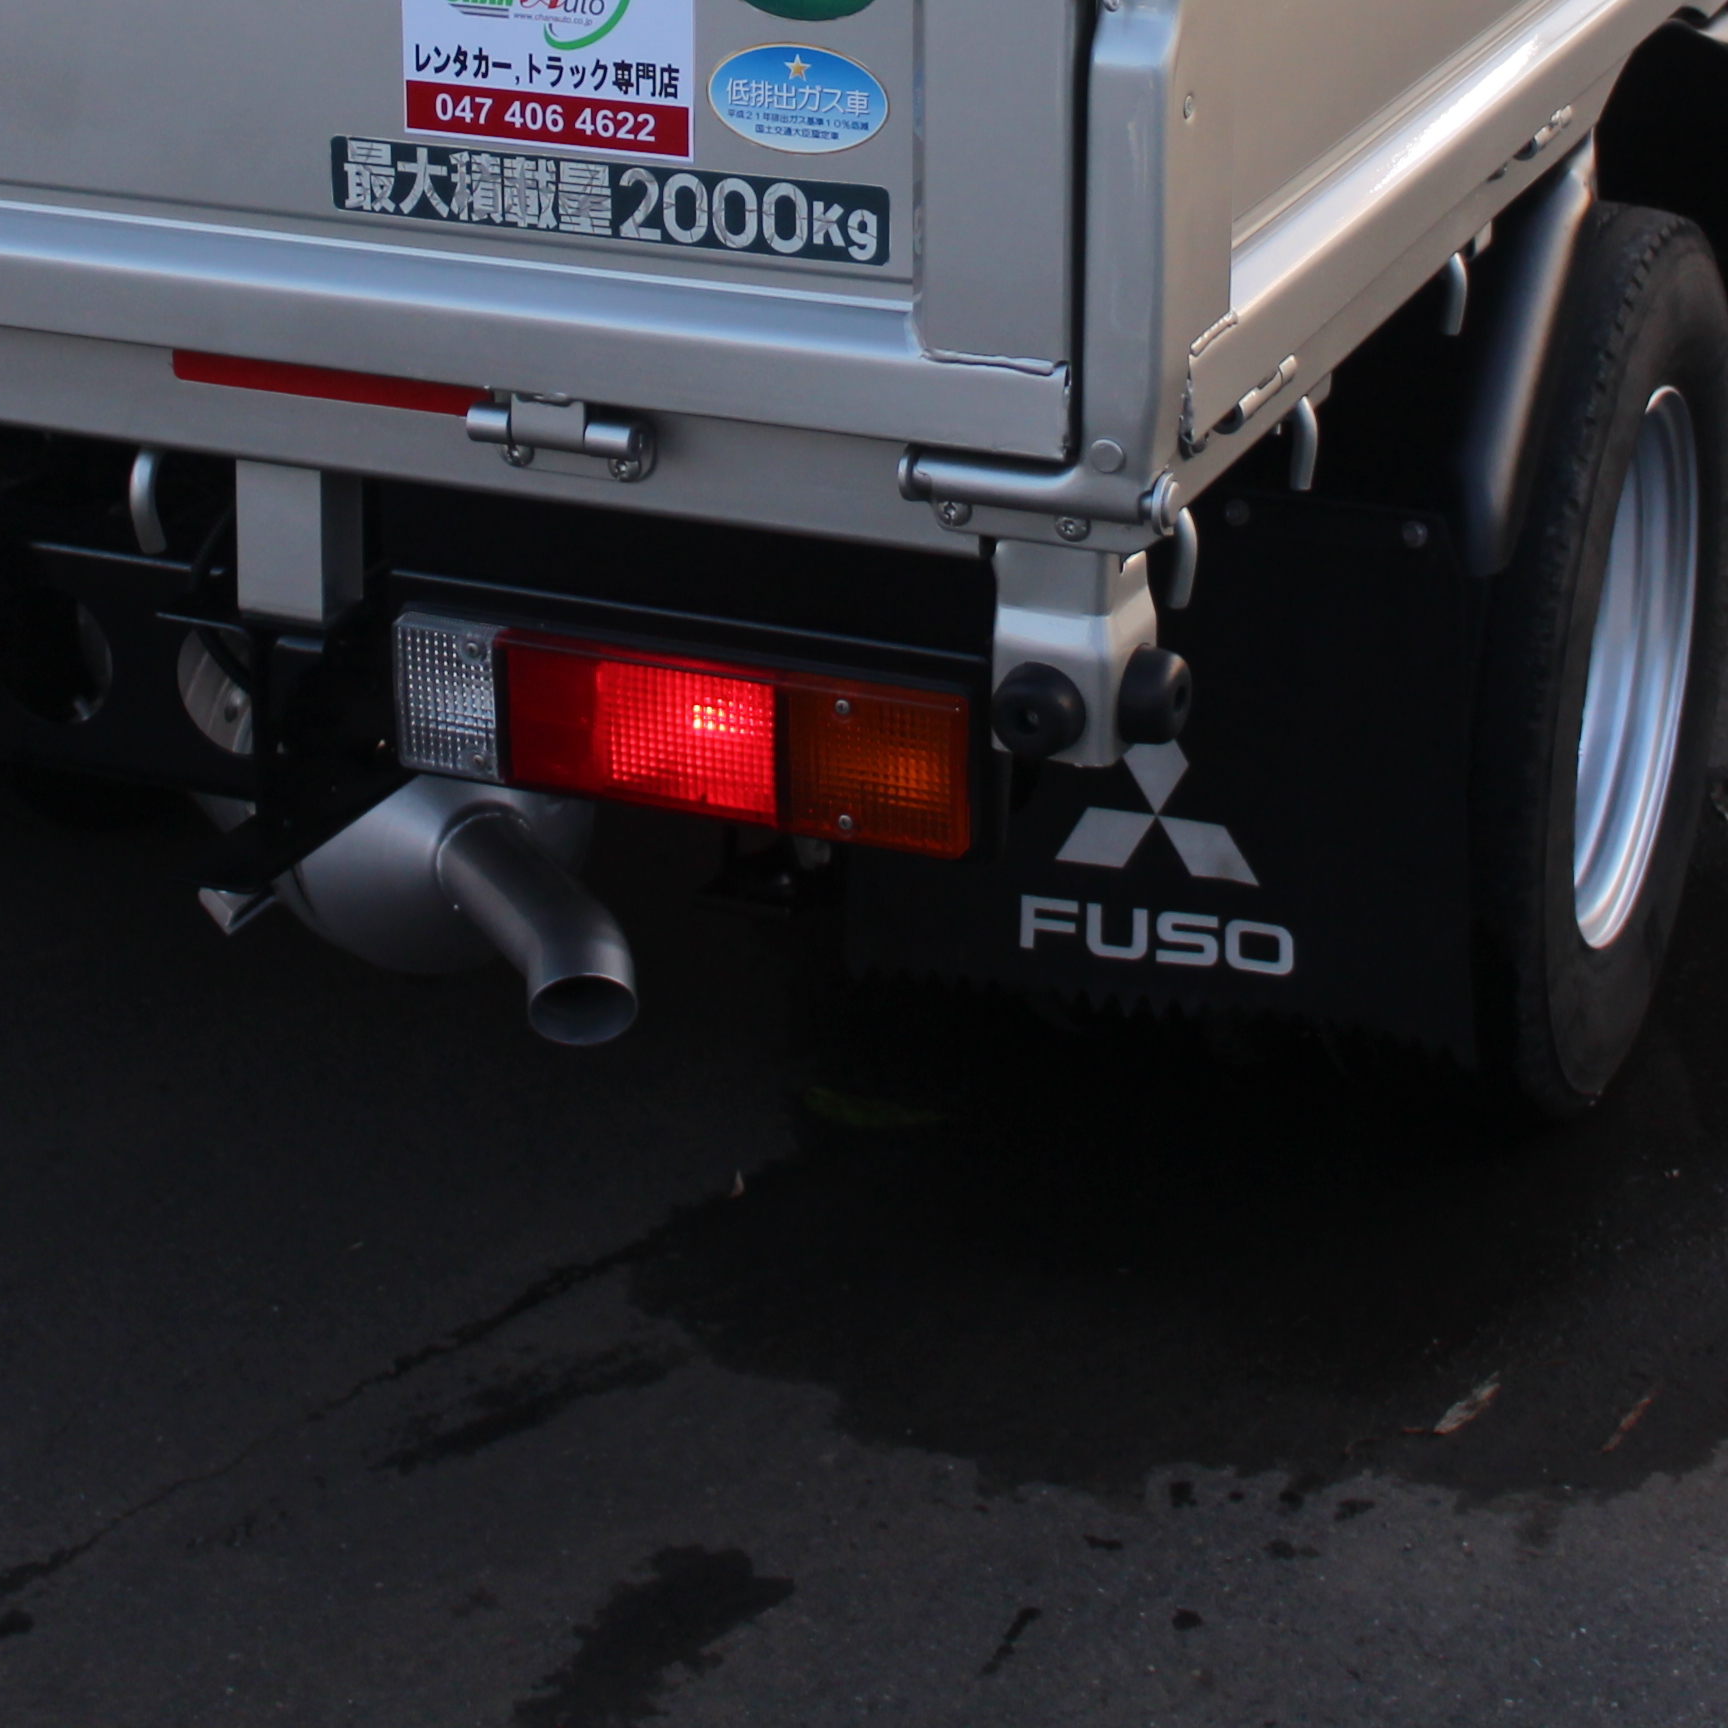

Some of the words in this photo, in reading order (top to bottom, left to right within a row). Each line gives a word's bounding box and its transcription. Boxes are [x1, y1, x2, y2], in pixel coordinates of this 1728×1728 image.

[435, 93, 493, 124] 047
[504, 100, 565, 132] 406
[575, 108, 656, 142] 4622
[725, 77, 871, 117] 低排出ガス車
[1019, 894, 1294, 975] FUSO
